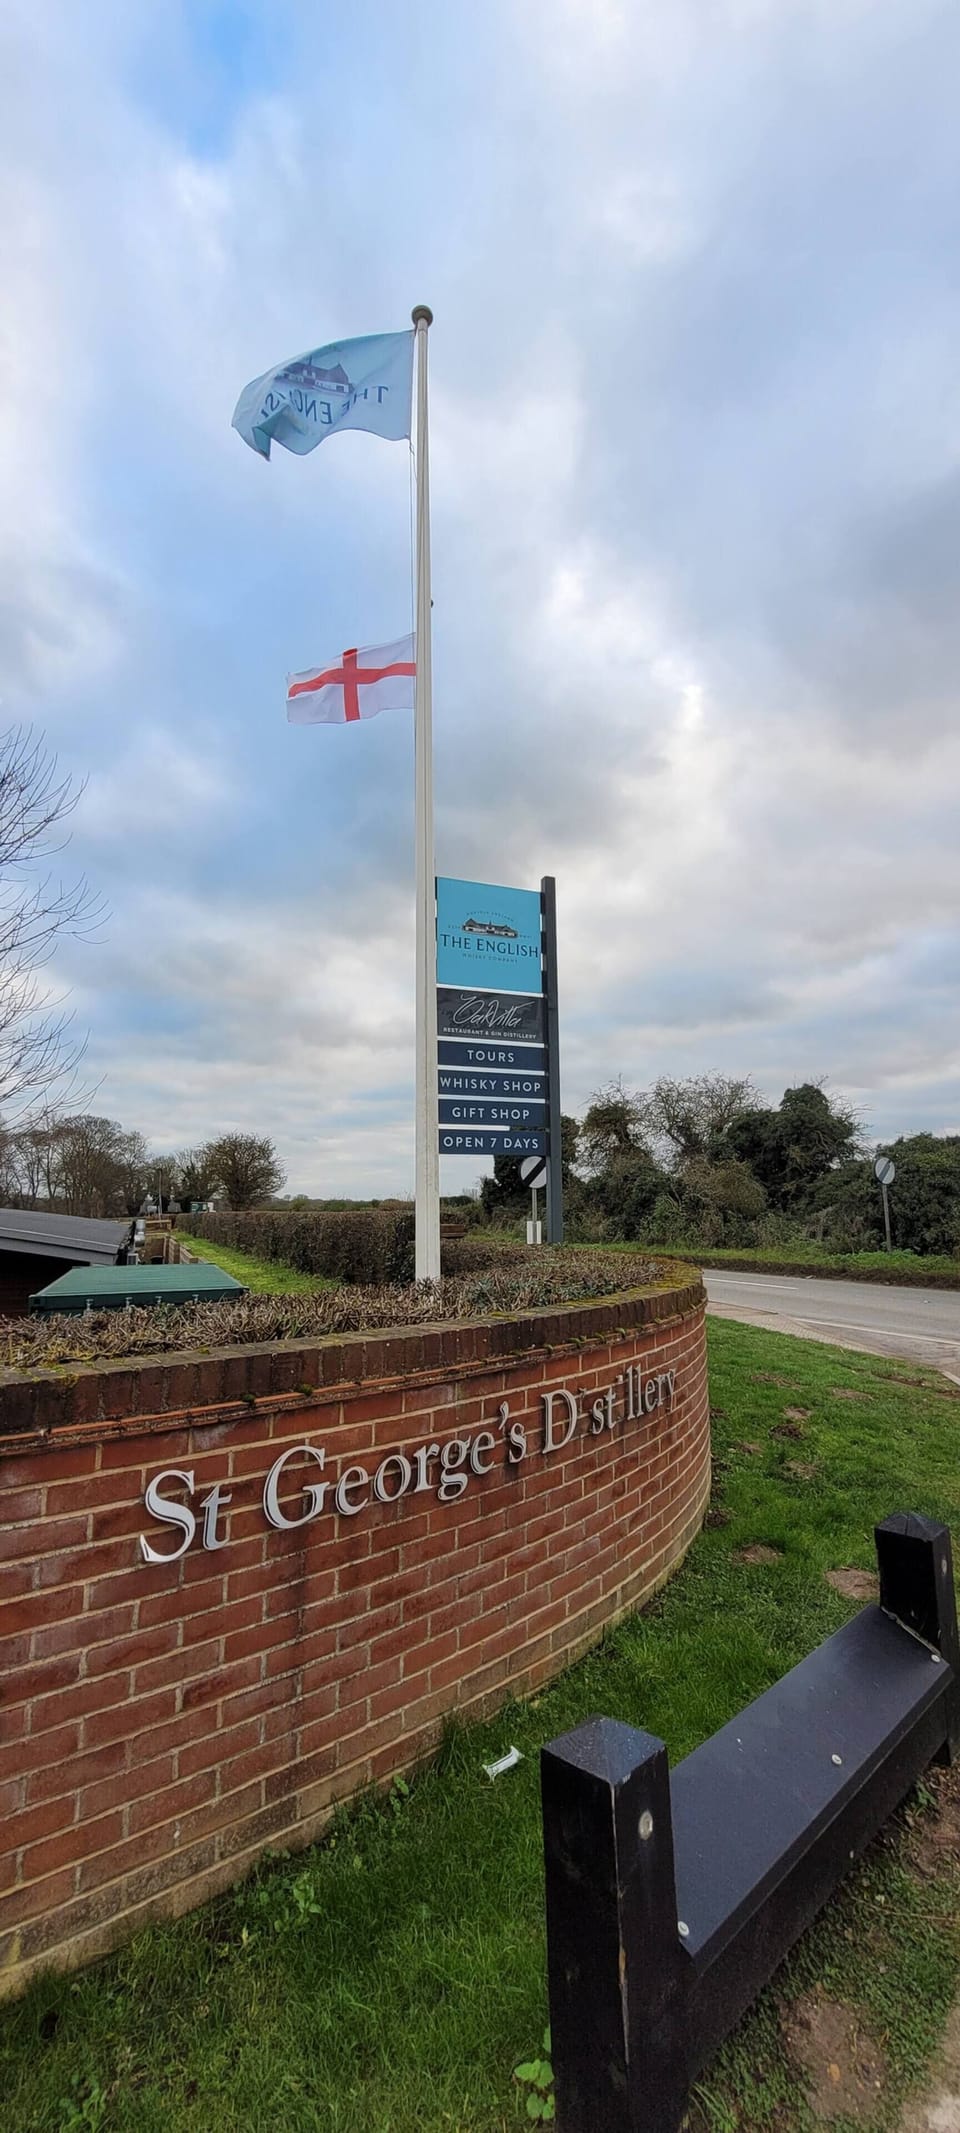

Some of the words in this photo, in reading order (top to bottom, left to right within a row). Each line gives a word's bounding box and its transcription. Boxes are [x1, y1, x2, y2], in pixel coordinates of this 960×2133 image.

[440, 933, 472, 950] THE
[477, 938, 538, 958] ENGLISH
[443, 1027, 483, 1036] RESTAURANT
[467, 1050, 515, 1063] TOURS
[440, 1077, 497, 1090] WHISKY
[503, 1080, 541, 1093] SHOP
[452, 1107, 485, 1119] GIFT
[491, 1108, 530, 1120] SHOP
[443, 1136, 484, 1148] OPEN
[490, 1138, 497, 1148] 7
[503, 1138, 539, 1149] DAYS
[139, 1469, 232, 1563] St
[263, 1400, 527, 1530] George's
[541, 1363, 676, 1455] Dstllery
